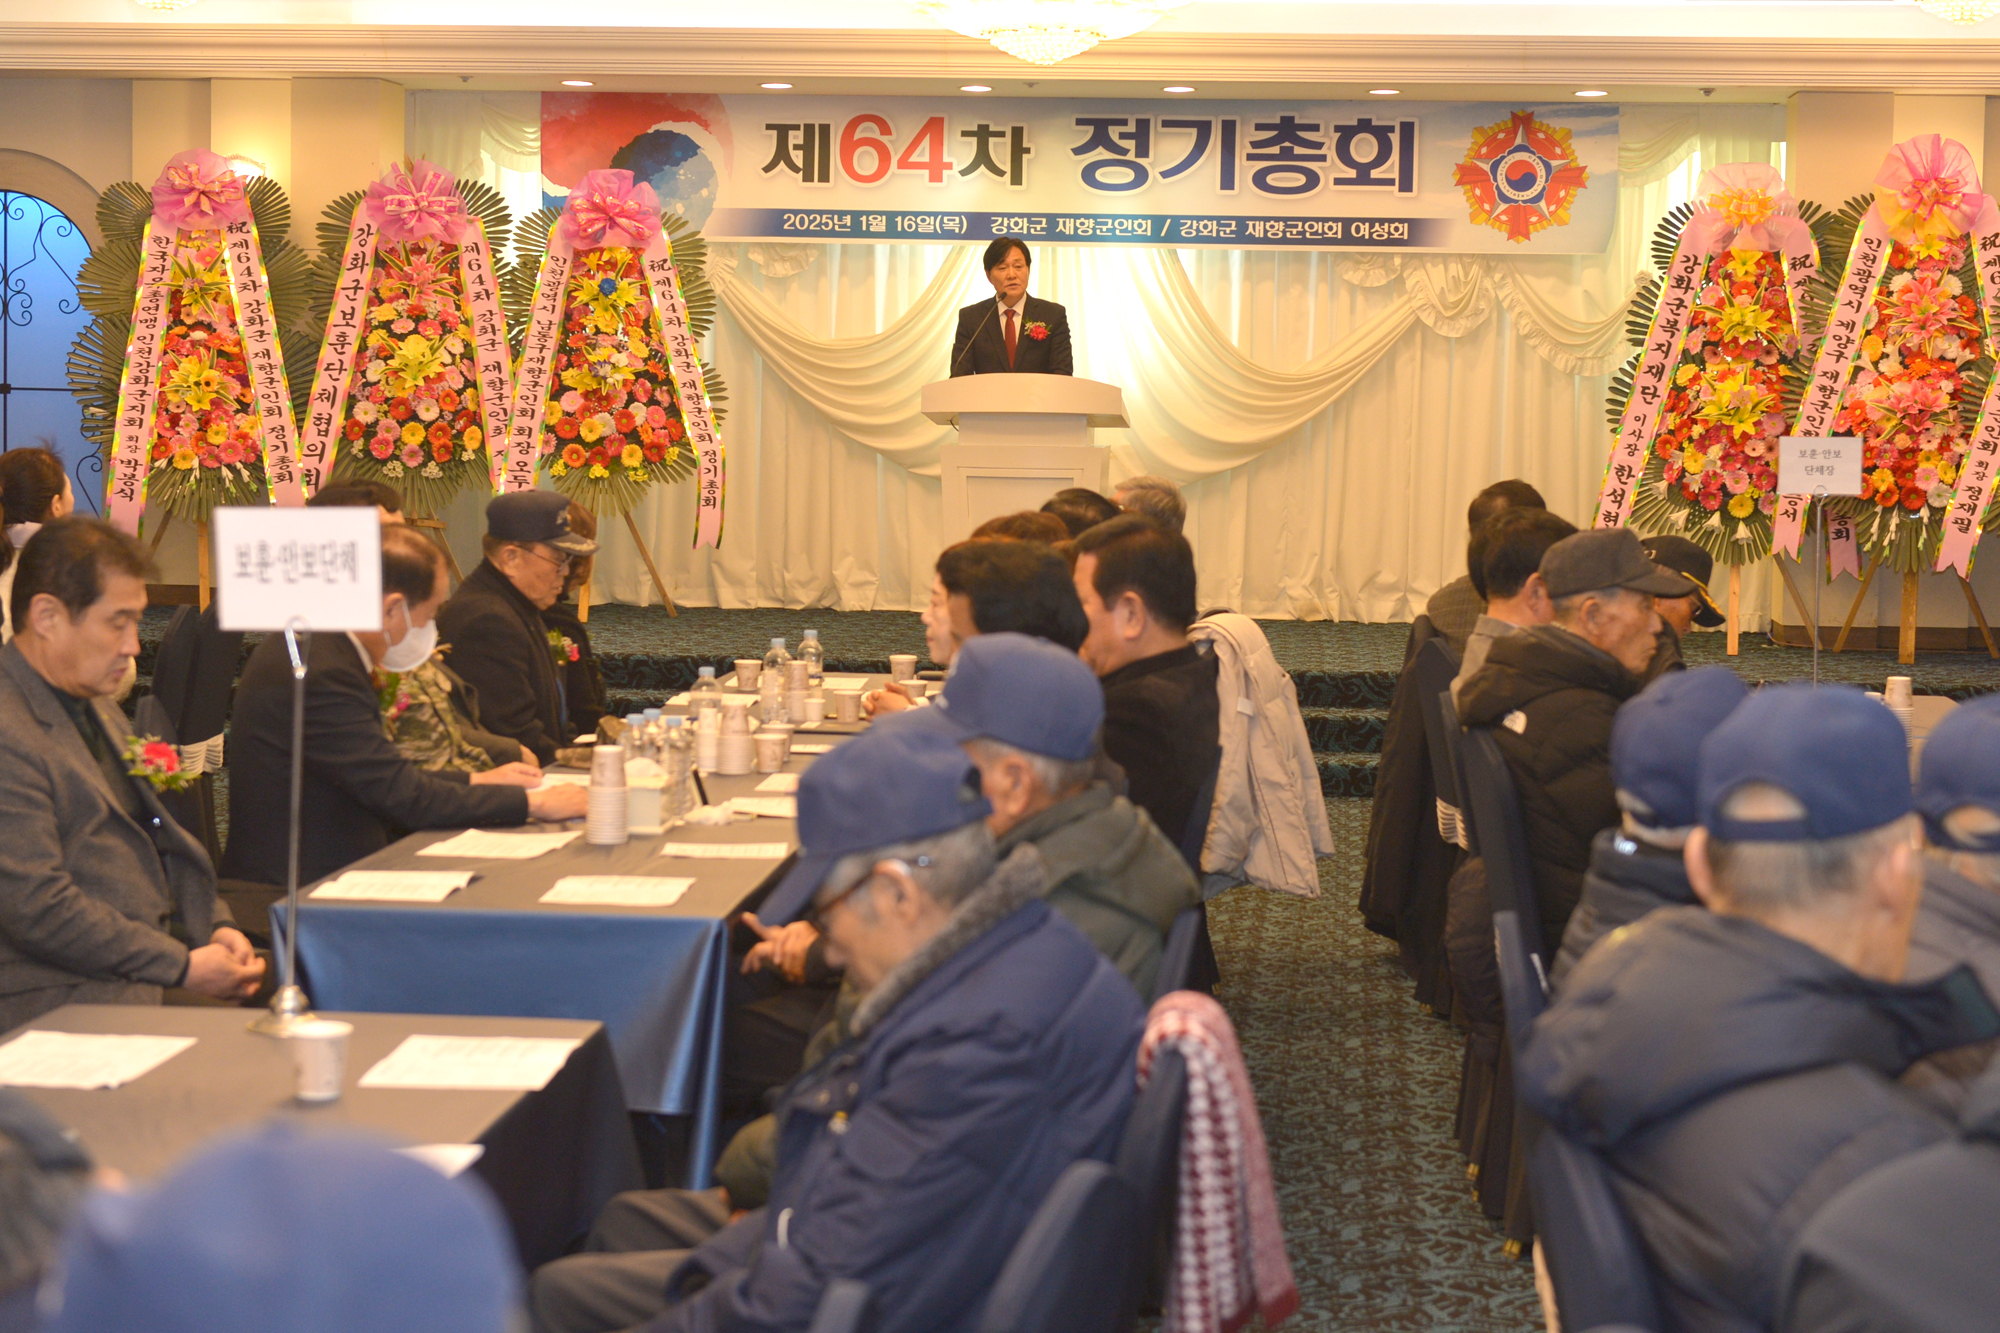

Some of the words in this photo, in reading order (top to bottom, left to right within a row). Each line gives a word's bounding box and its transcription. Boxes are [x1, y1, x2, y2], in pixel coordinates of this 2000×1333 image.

[761, 113, 1031, 186] 제64차
[1070, 115, 1415, 196] 정기총회
[226, 221, 251, 234] 祝
[783, 213, 851, 232] 2025년
[859, 214, 887, 232] 1월
[895, 215, 967, 234] 16일(목)
[990, 216, 1048, 235] 강화군
[1056, 217, 1152, 236] 재향군인회
[1161, 219, 1171, 236] /
[1180, 219, 1237, 237] 강화군
[1245, 220, 1342, 239] 재향군인회
[1351, 221, 1409, 240] 여성회
[229, 238, 262, 293] 제64차
[463, 242, 495, 303] 제64차
[648, 258, 672, 272] 祝
[1789, 254, 1814, 271] 祝
[1841, 237, 1882, 314] 인천광역시
[243, 299, 271, 343] 강화군
[653, 276, 686, 328] 제64차
[476, 309, 502, 352] 강화군
[670, 334, 695, 373] 강화군
[251, 348, 283, 419] 재향군인회
[680, 379, 713, 444] 재향군인회
[125, 435, 141, 453] 회장
[267, 425, 294, 484] 정기총회
[511, 426, 535, 455] 회장
[1623, 413, 1647, 457] 이사장
[506, 460, 535, 493] 오두
[701, 449, 719, 510] 정기총회
[1804, 465, 1835, 476] 단체장
[1970, 459, 1989, 481] 회장
[1951, 484, 1983, 534] 정재필
